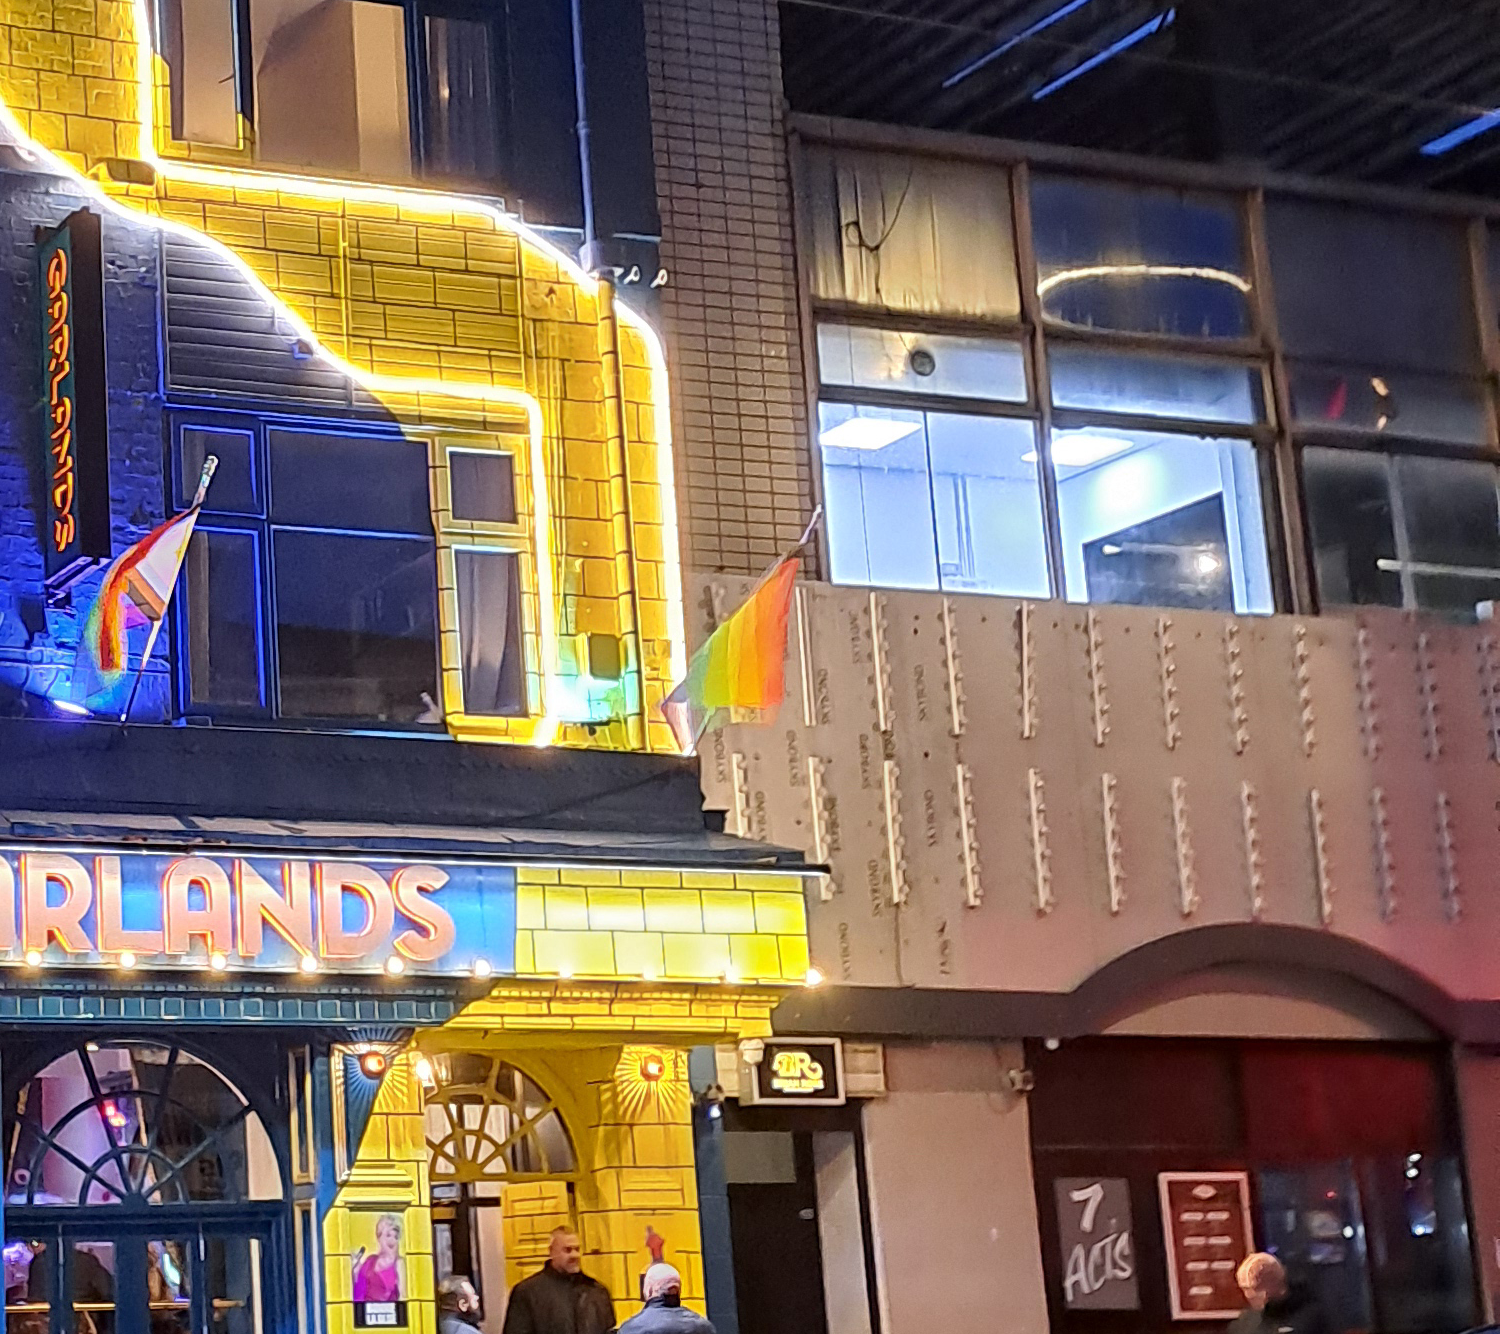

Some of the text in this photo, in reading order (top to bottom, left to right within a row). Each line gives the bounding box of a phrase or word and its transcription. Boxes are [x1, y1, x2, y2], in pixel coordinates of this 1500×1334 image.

[47, 247, 75, 552] GARLANDS
[1069, 1182, 1104, 1233] 7
[1063, 1230, 1132, 1303] ACTS
